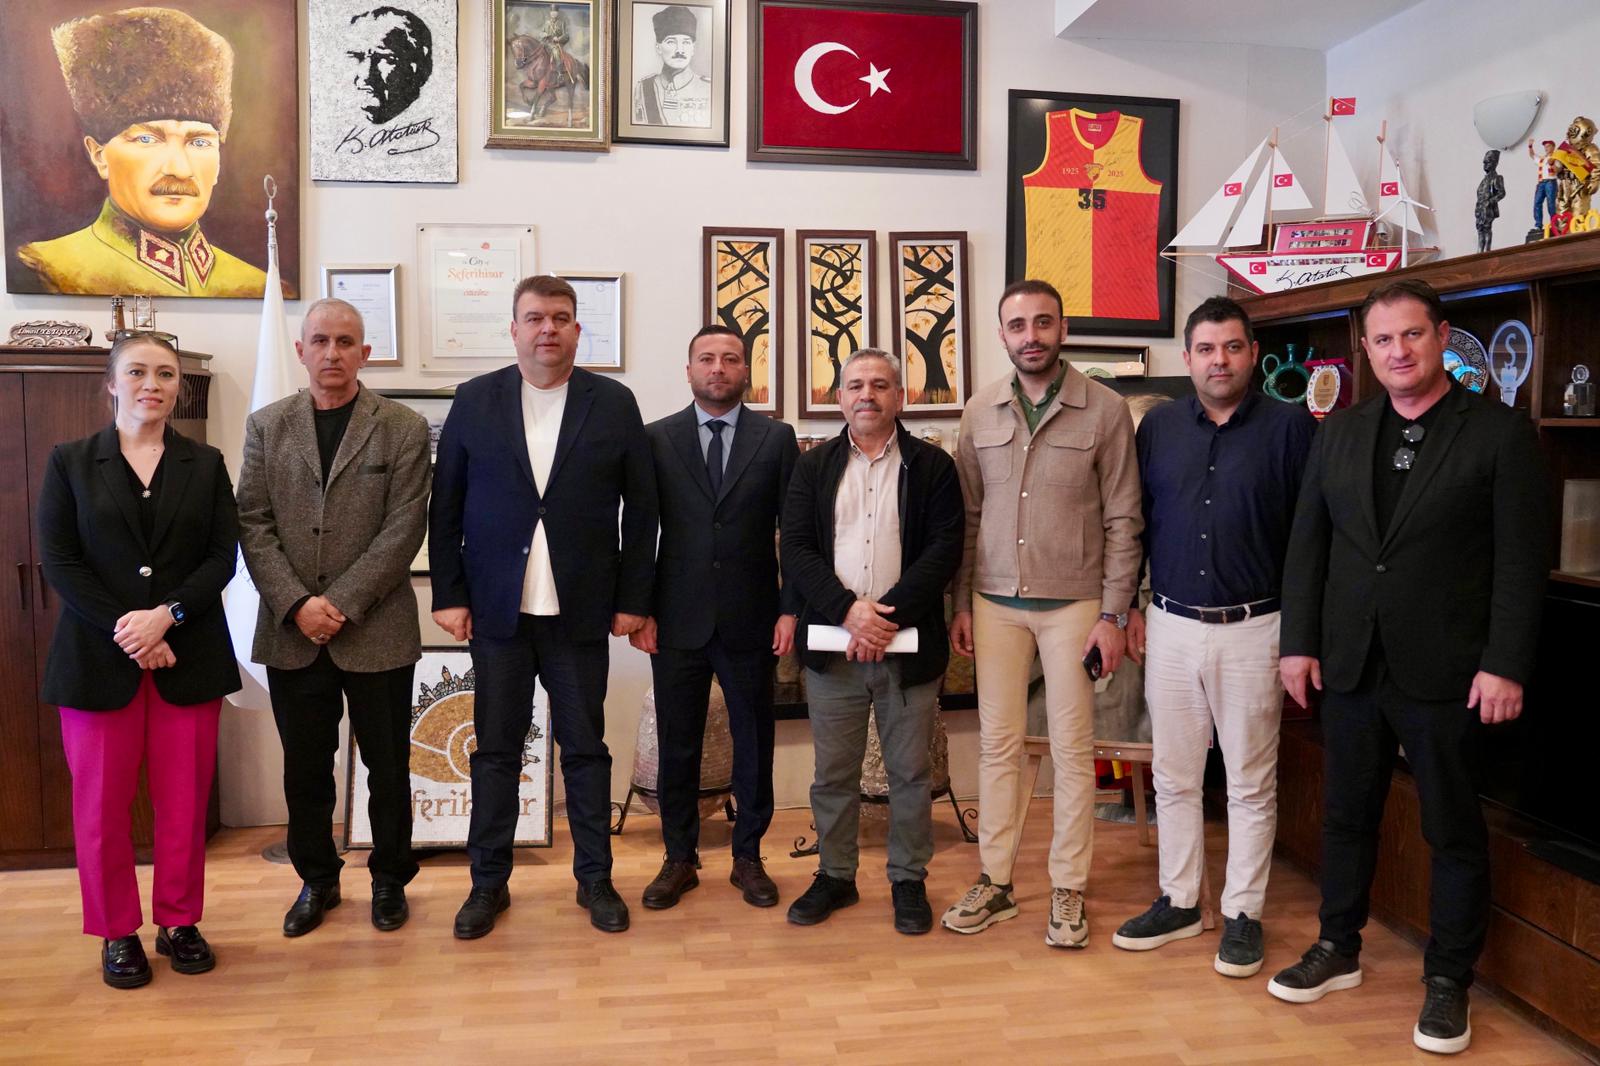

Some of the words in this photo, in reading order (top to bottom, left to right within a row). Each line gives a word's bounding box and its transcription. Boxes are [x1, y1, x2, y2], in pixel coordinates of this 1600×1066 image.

[1062, 167, 1079, 175] 1925
[1107, 169, 1124, 177] 2025
[1078, 188, 1106, 210] 35
[1570, 208, 1600, 233] GÖ
[412, 789, 536, 822] ferihr
